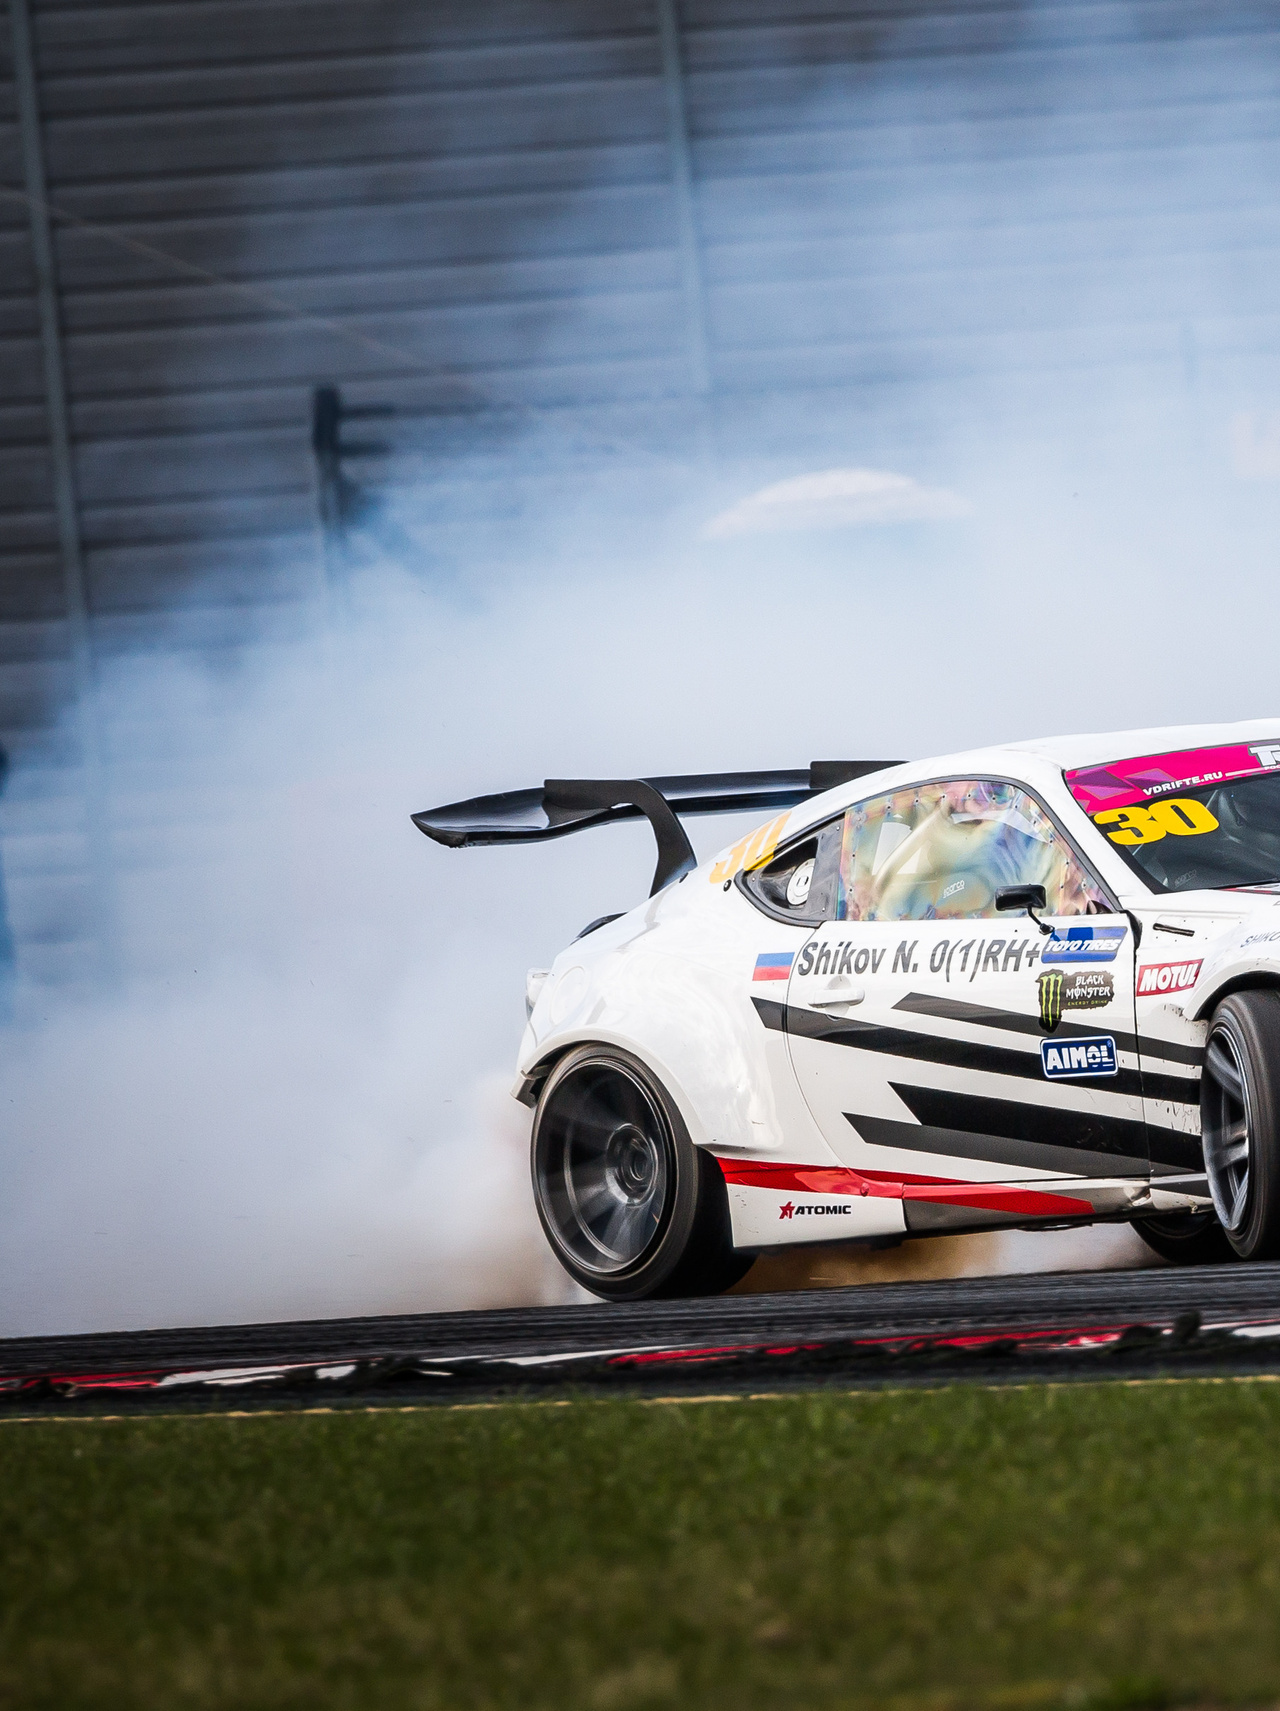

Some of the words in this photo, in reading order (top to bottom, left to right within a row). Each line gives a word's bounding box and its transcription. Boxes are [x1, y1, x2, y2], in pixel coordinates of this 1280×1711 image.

[1142, 771, 1223, 796] VDRIFTE.RU
[1093, 798, 1220, 845] 30
[798, 941, 887, 976] Shikov
[891, 939, 919, 973] N.
[1045, 939, 1083, 952] TOYO
[1080, 938, 1122, 951] TIRES
[1075, 974, 1104, 986] BLACK
[1139, 963, 1199, 992] MOTUL
[1047, 1044, 1114, 1070] AIMOL
[795, 1205, 852, 1215] ATOMIC
